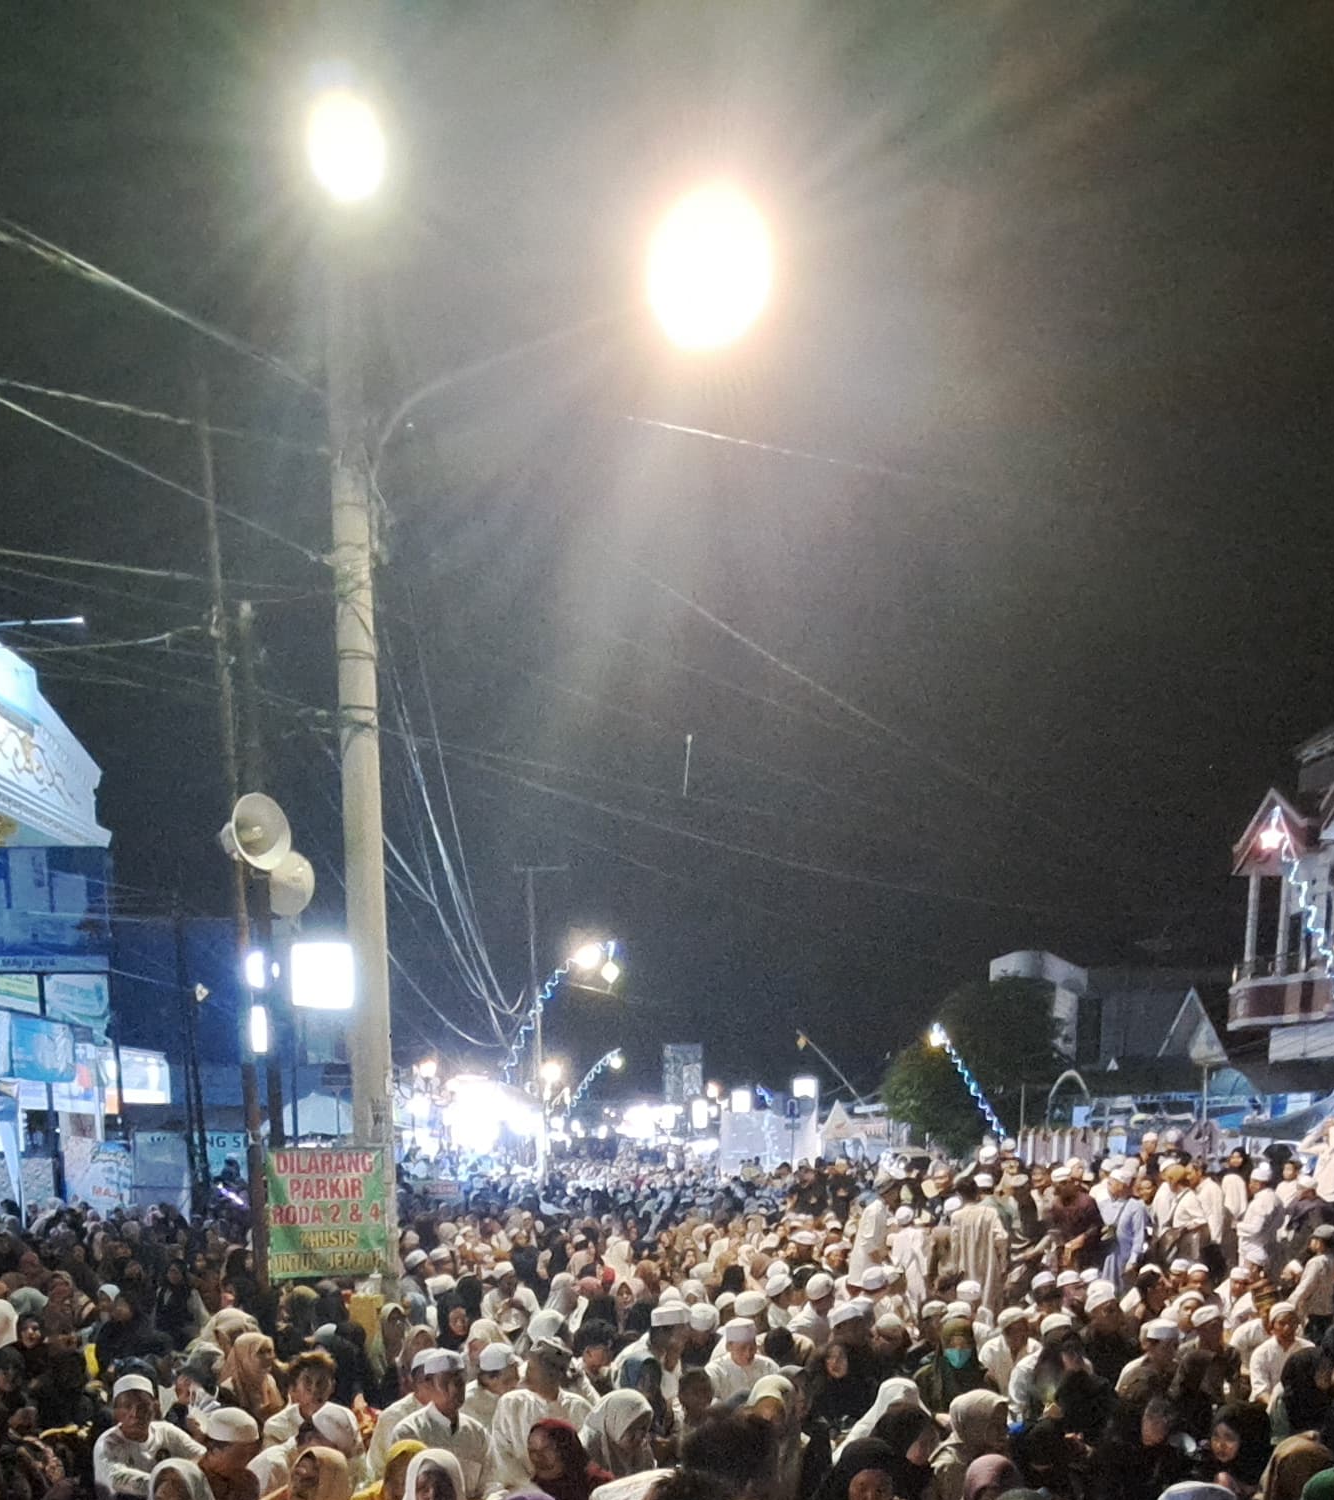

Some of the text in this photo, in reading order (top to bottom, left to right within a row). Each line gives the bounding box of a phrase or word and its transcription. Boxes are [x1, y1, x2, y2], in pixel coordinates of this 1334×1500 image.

[275, 1151, 373, 1175] DILARANG
[289, 1178, 363, 1199] PARKIR
[272, 1202, 381, 1225] RODA 2 & 4
[299, 1229, 359, 1248] KHUSUS
[274, 1251, 322, 1272] UNTUK
